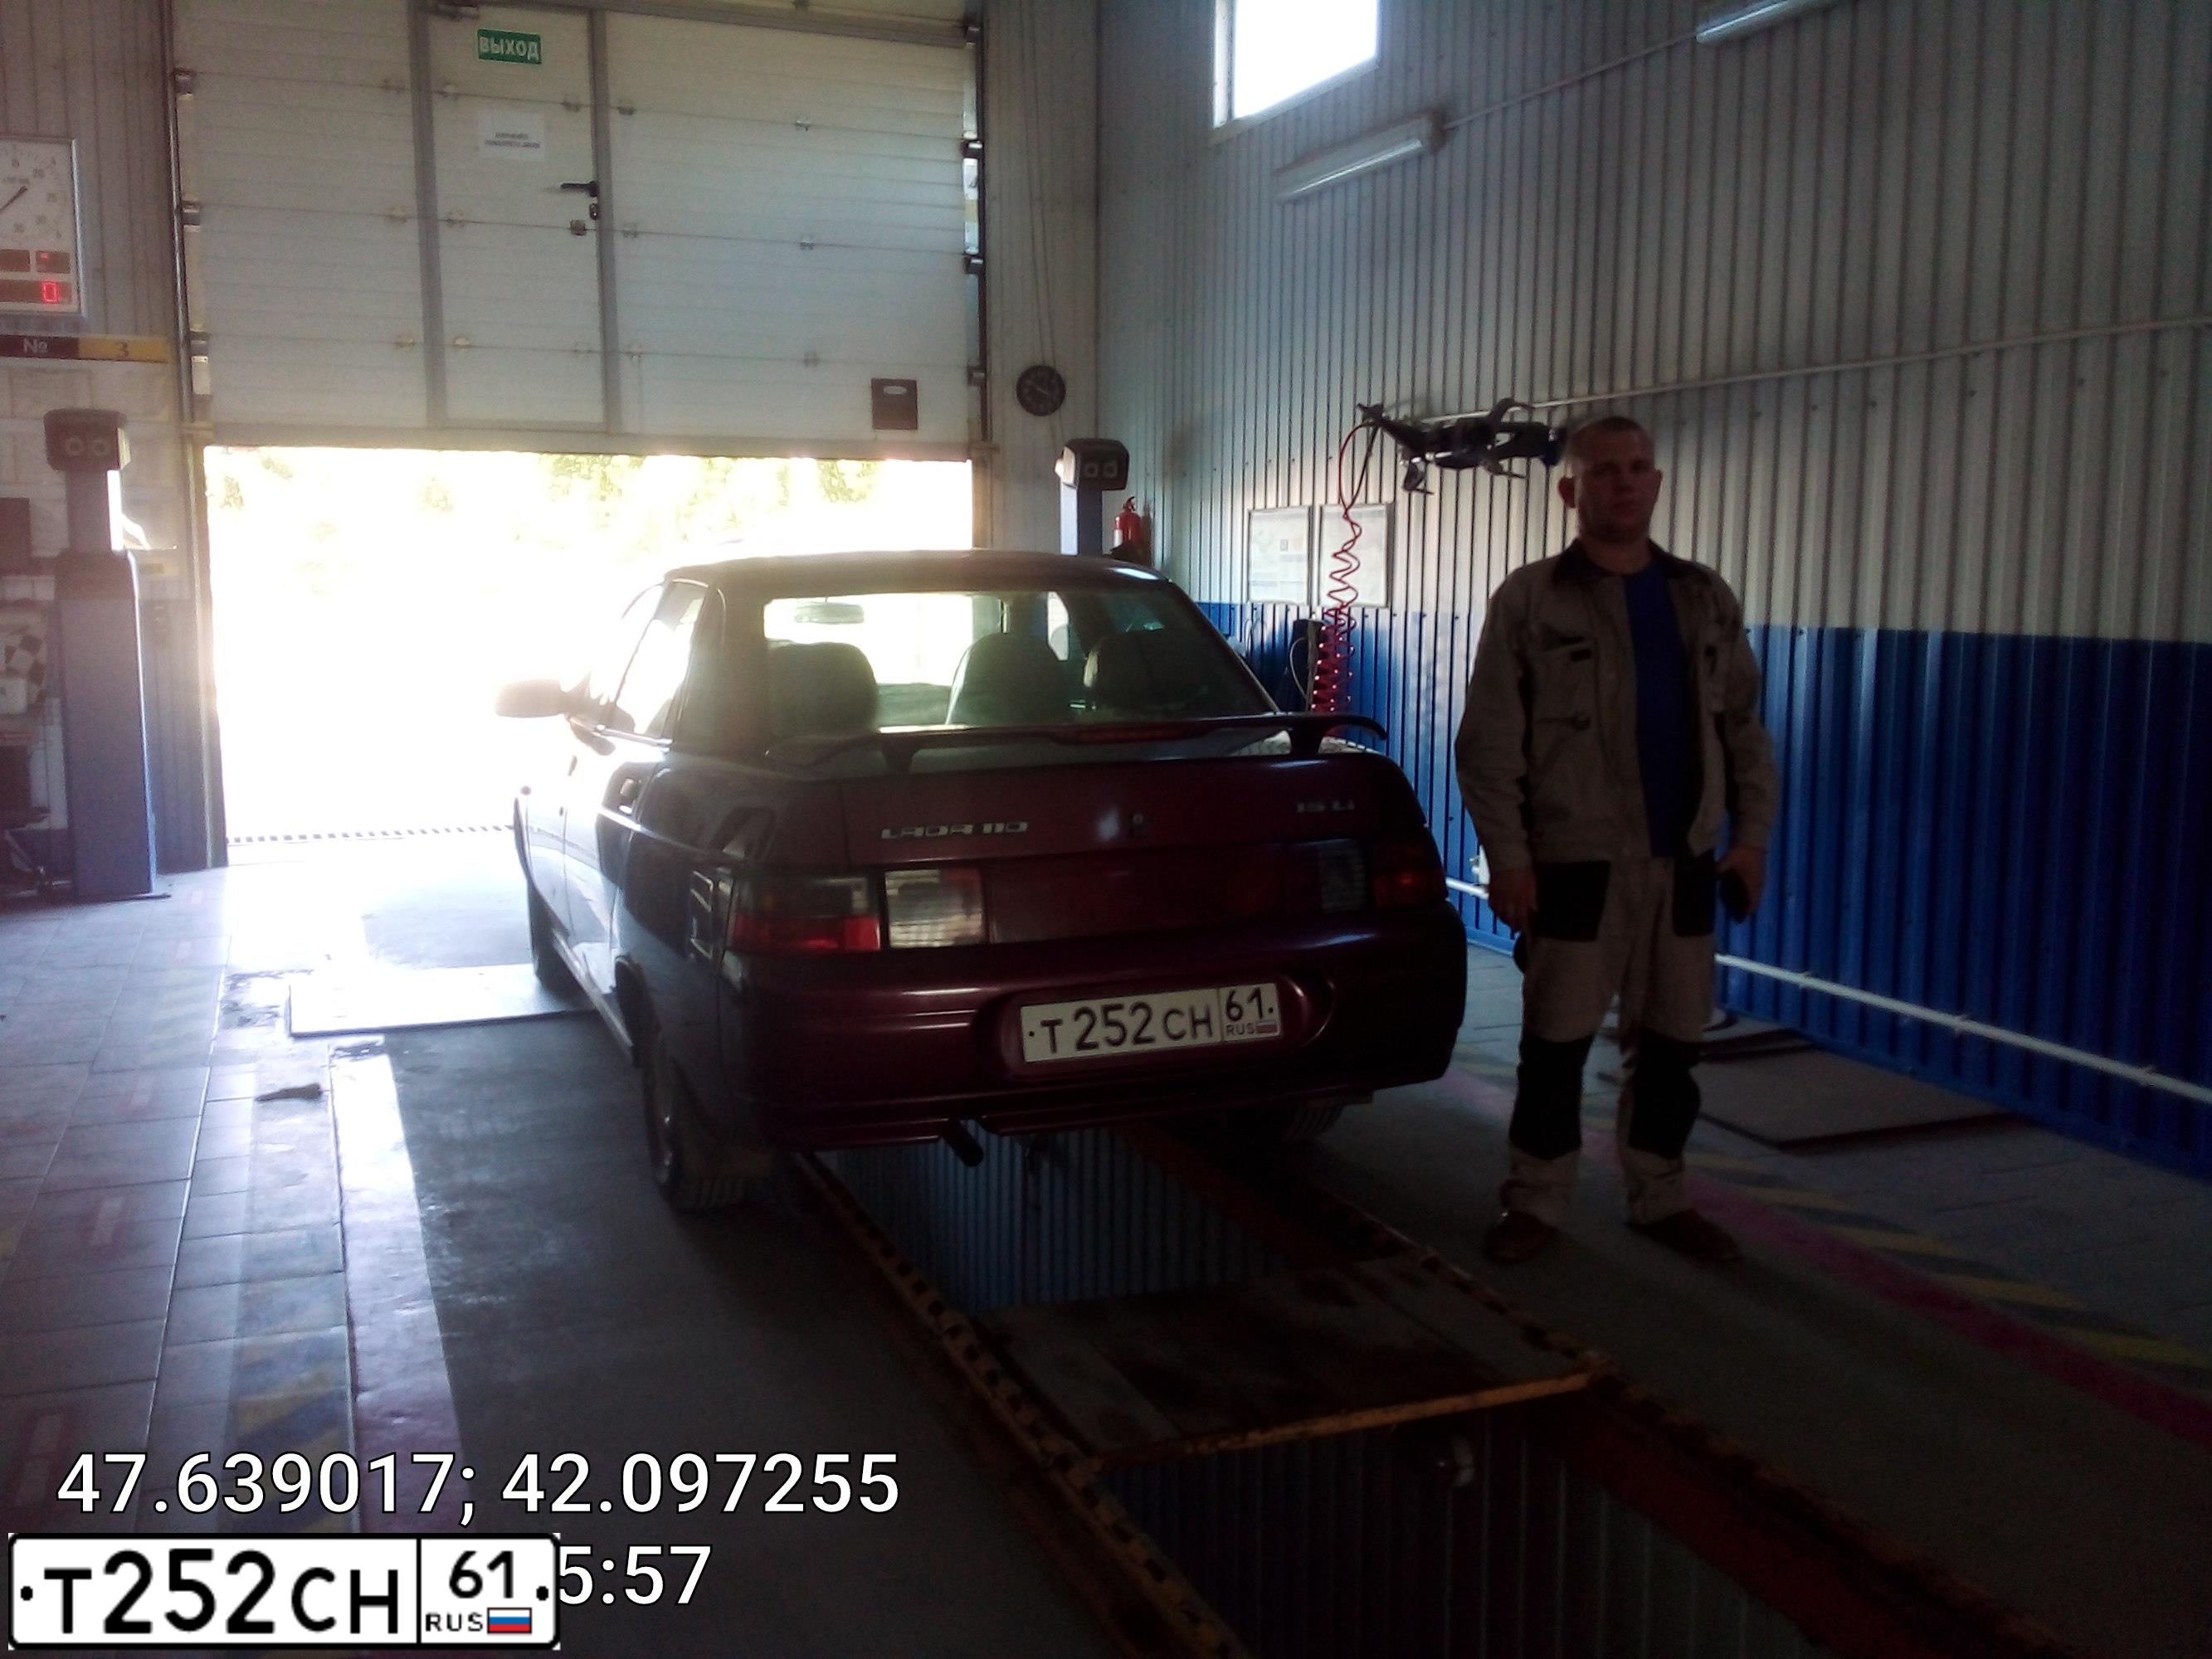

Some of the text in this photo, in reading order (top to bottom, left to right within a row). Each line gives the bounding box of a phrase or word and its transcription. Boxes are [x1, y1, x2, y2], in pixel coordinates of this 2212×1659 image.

[480, 36, 539, 61] ВЫХОД
[881, 821, 1028, 839] LADA 110
[1225, 987, 1264, 1021] 61
[1225, 1022, 1256, 1036] RUS
